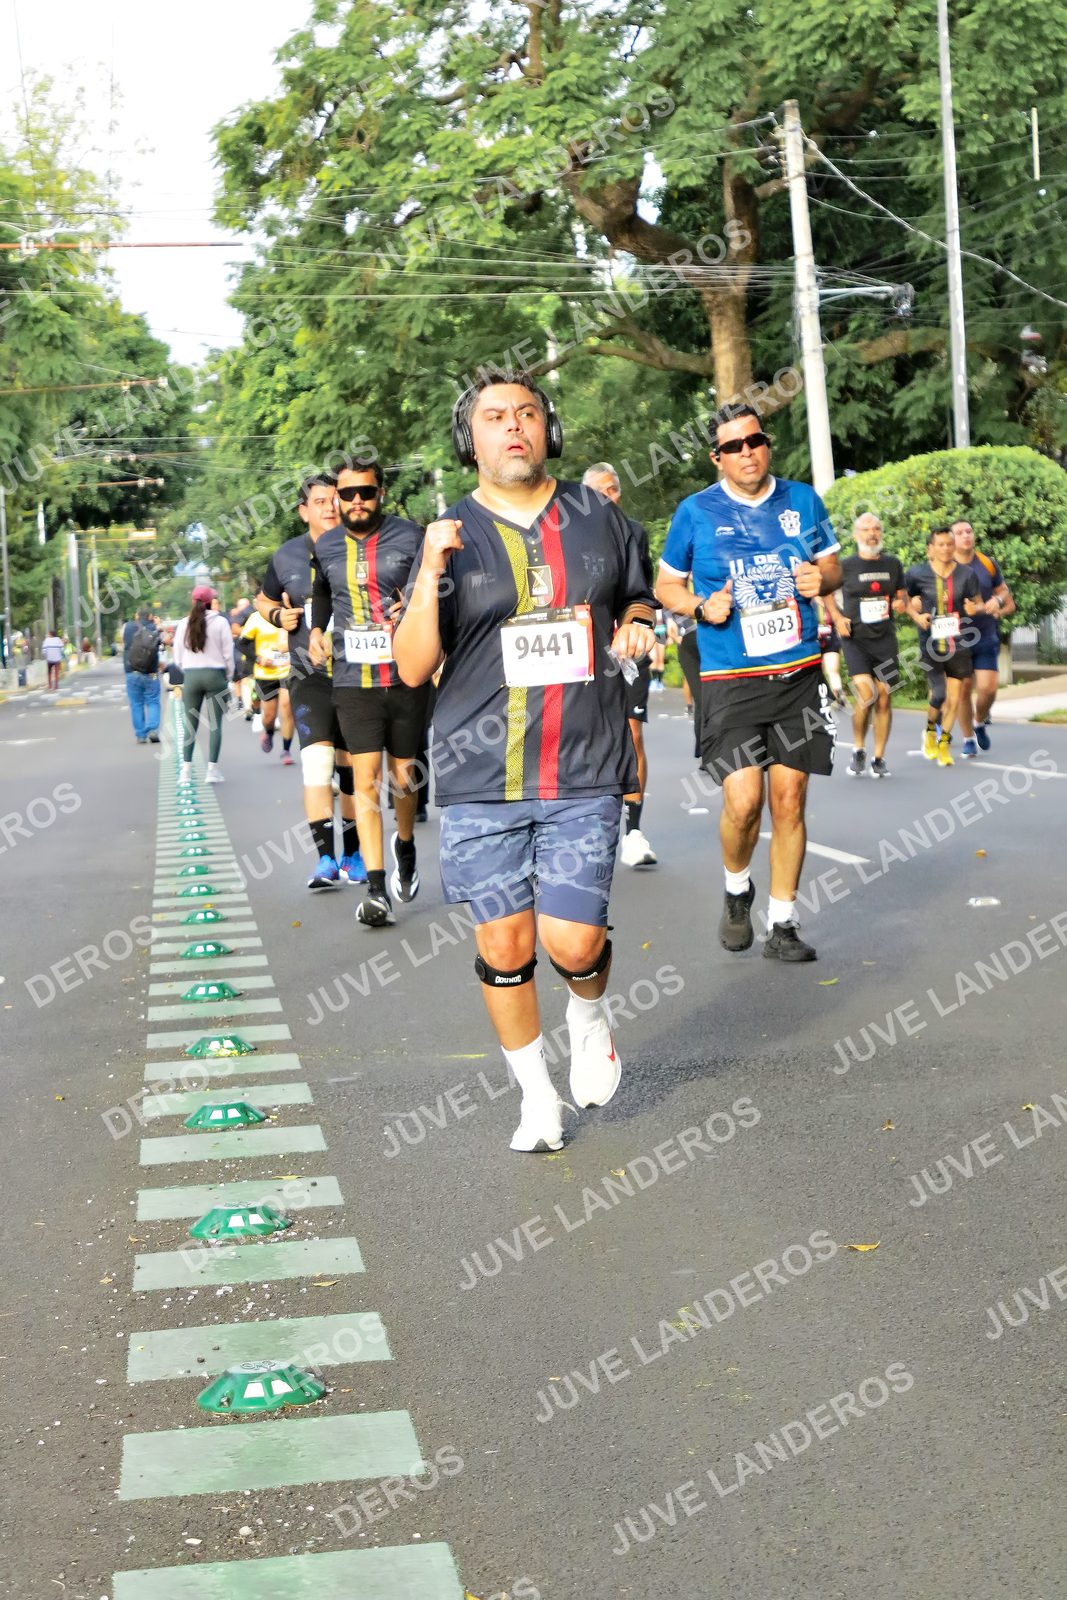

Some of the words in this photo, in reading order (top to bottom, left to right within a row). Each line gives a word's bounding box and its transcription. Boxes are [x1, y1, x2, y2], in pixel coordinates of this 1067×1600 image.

[753, 554, 780, 566] DE
[747, 615, 794, 639] 10823
[349, 636, 386, 649] 12142
[515, 632, 573, 660] 9441
